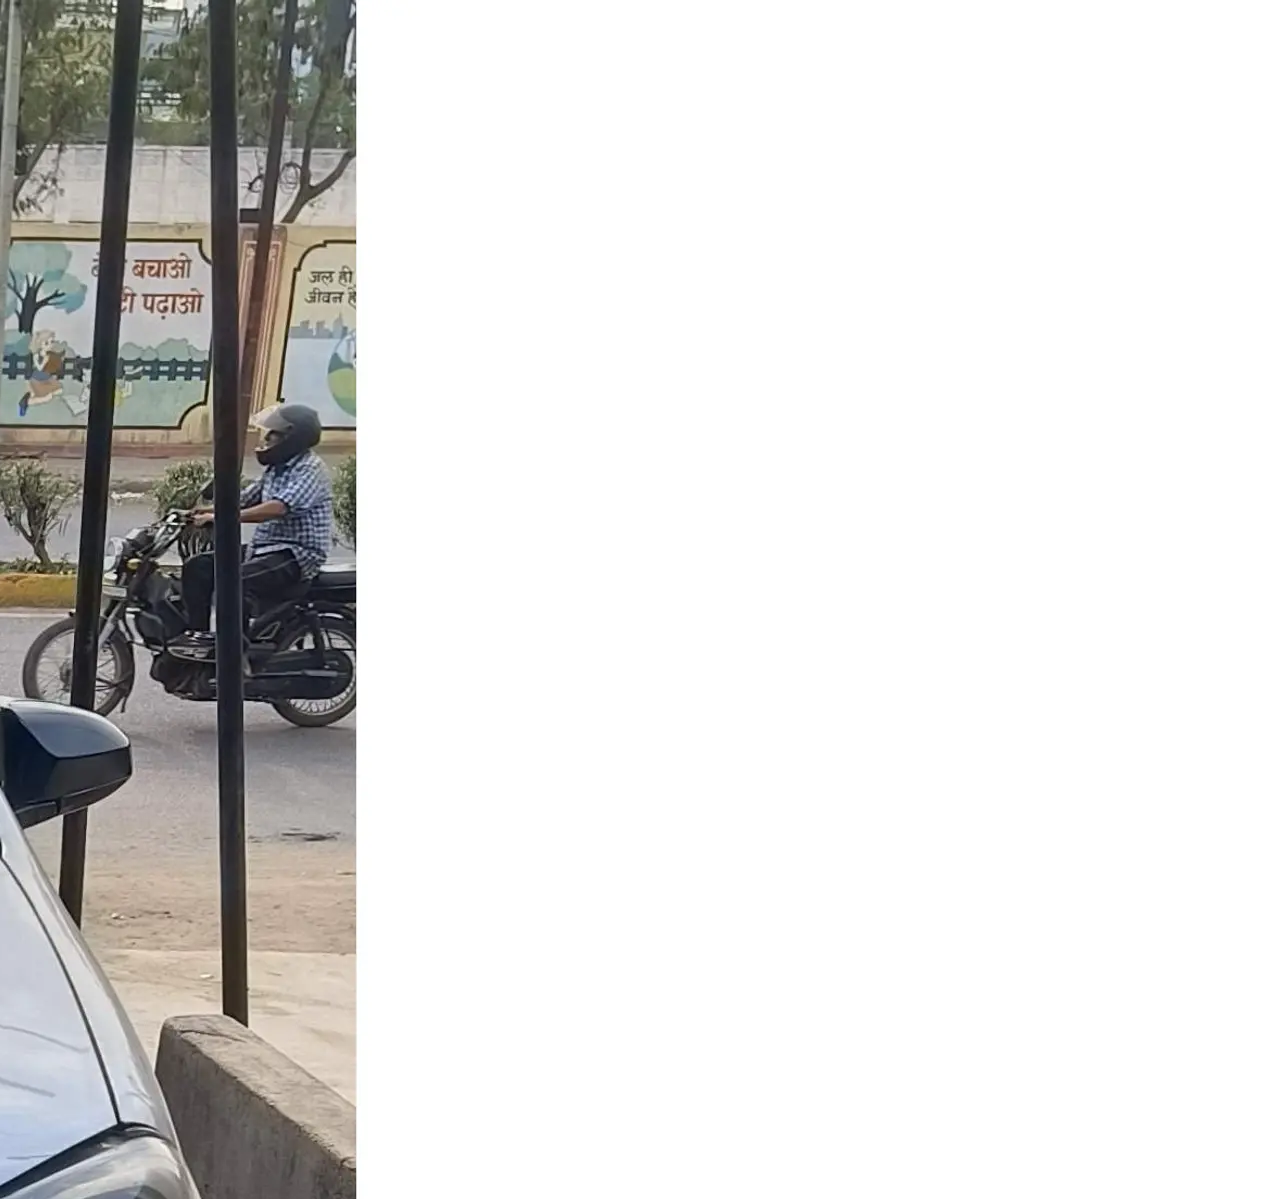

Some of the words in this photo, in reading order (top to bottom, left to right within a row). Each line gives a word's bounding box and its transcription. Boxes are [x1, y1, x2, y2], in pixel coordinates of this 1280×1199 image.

[132, 252, 192, 279] बचाओ
[308, 270, 336, 287] जल
[338, 265, 353, 287] ही
[141, 287, 205, 320] पढ़ाओ
[304, 287, 345, 304] जीवन
